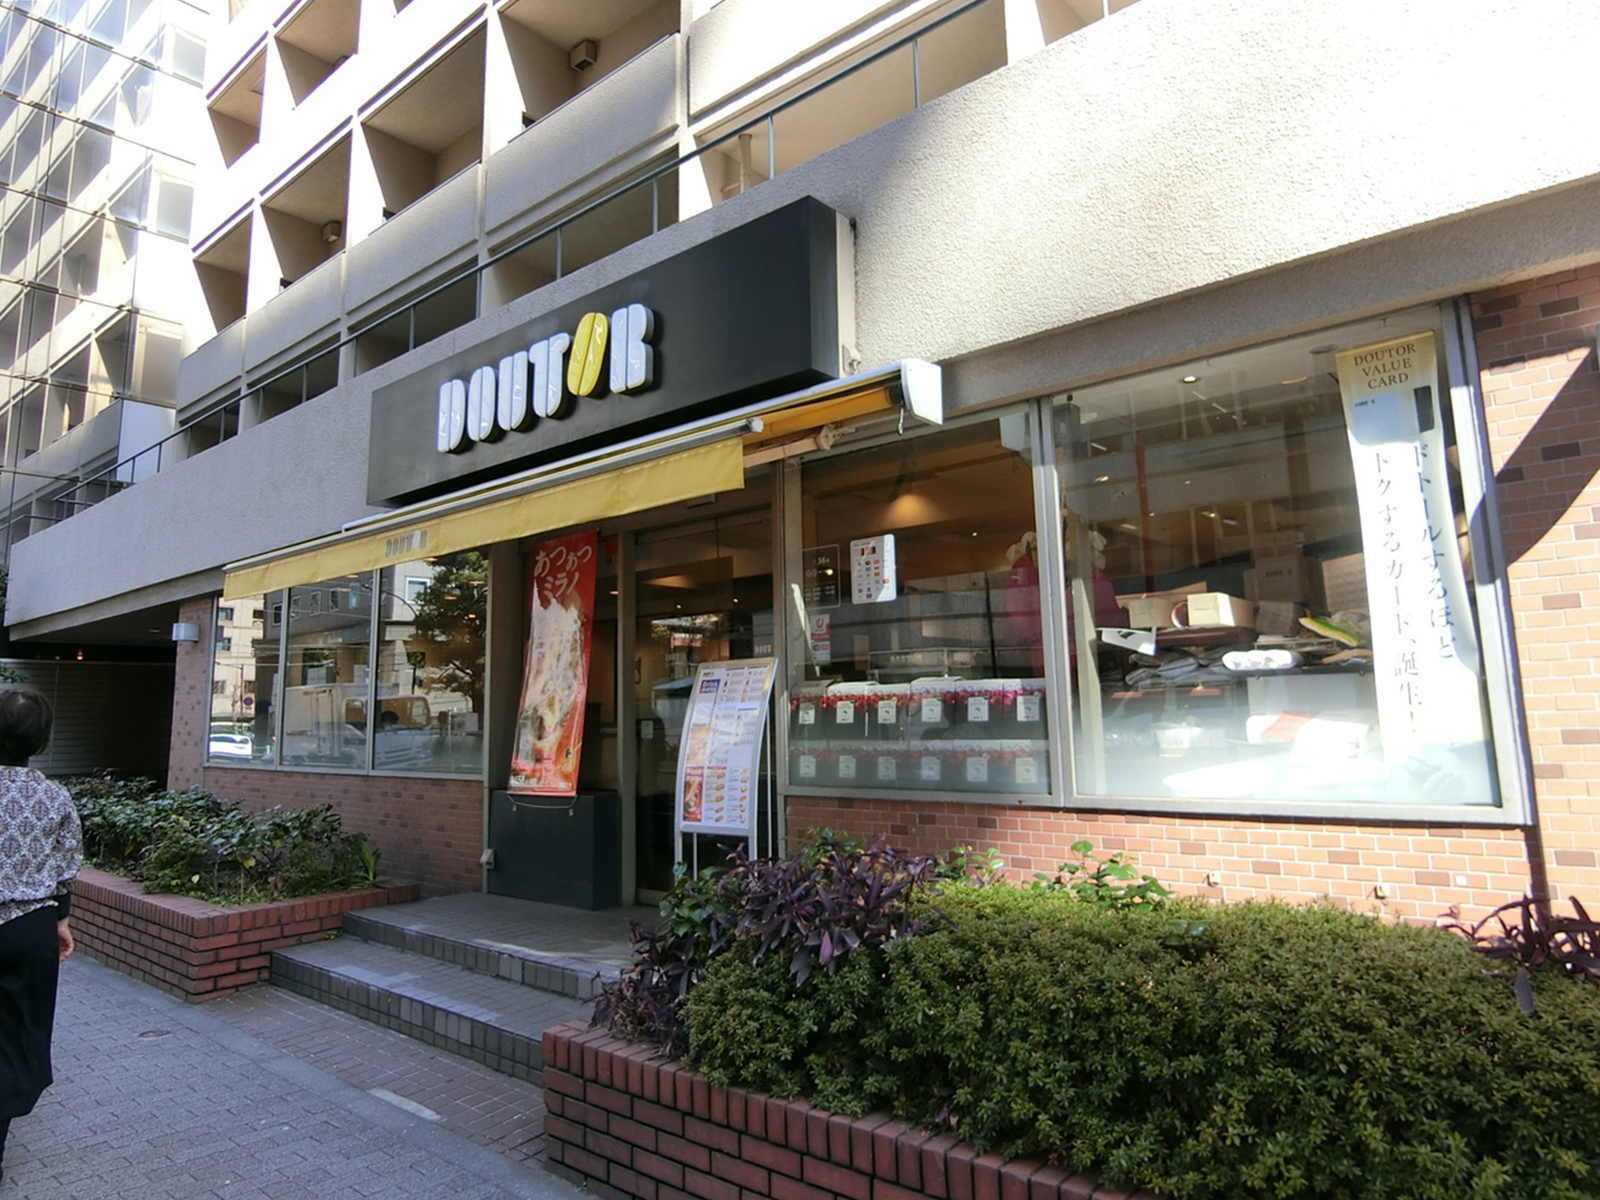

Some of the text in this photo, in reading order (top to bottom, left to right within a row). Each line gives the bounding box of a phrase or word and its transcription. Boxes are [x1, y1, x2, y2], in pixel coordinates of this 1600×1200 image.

[1353, 343, 1417, 367] DOUTOR
[1361, 357, 1412, 378] VALUE
[437, 302, 655, 454] DOUTOR
[1367, 372, 1409, 390] CARD
[534, 545, 593, 578] あつあつ
[1413, 443, 1457, 659] ドトールするほど
[543, 571, 580, 600] ミラノ
